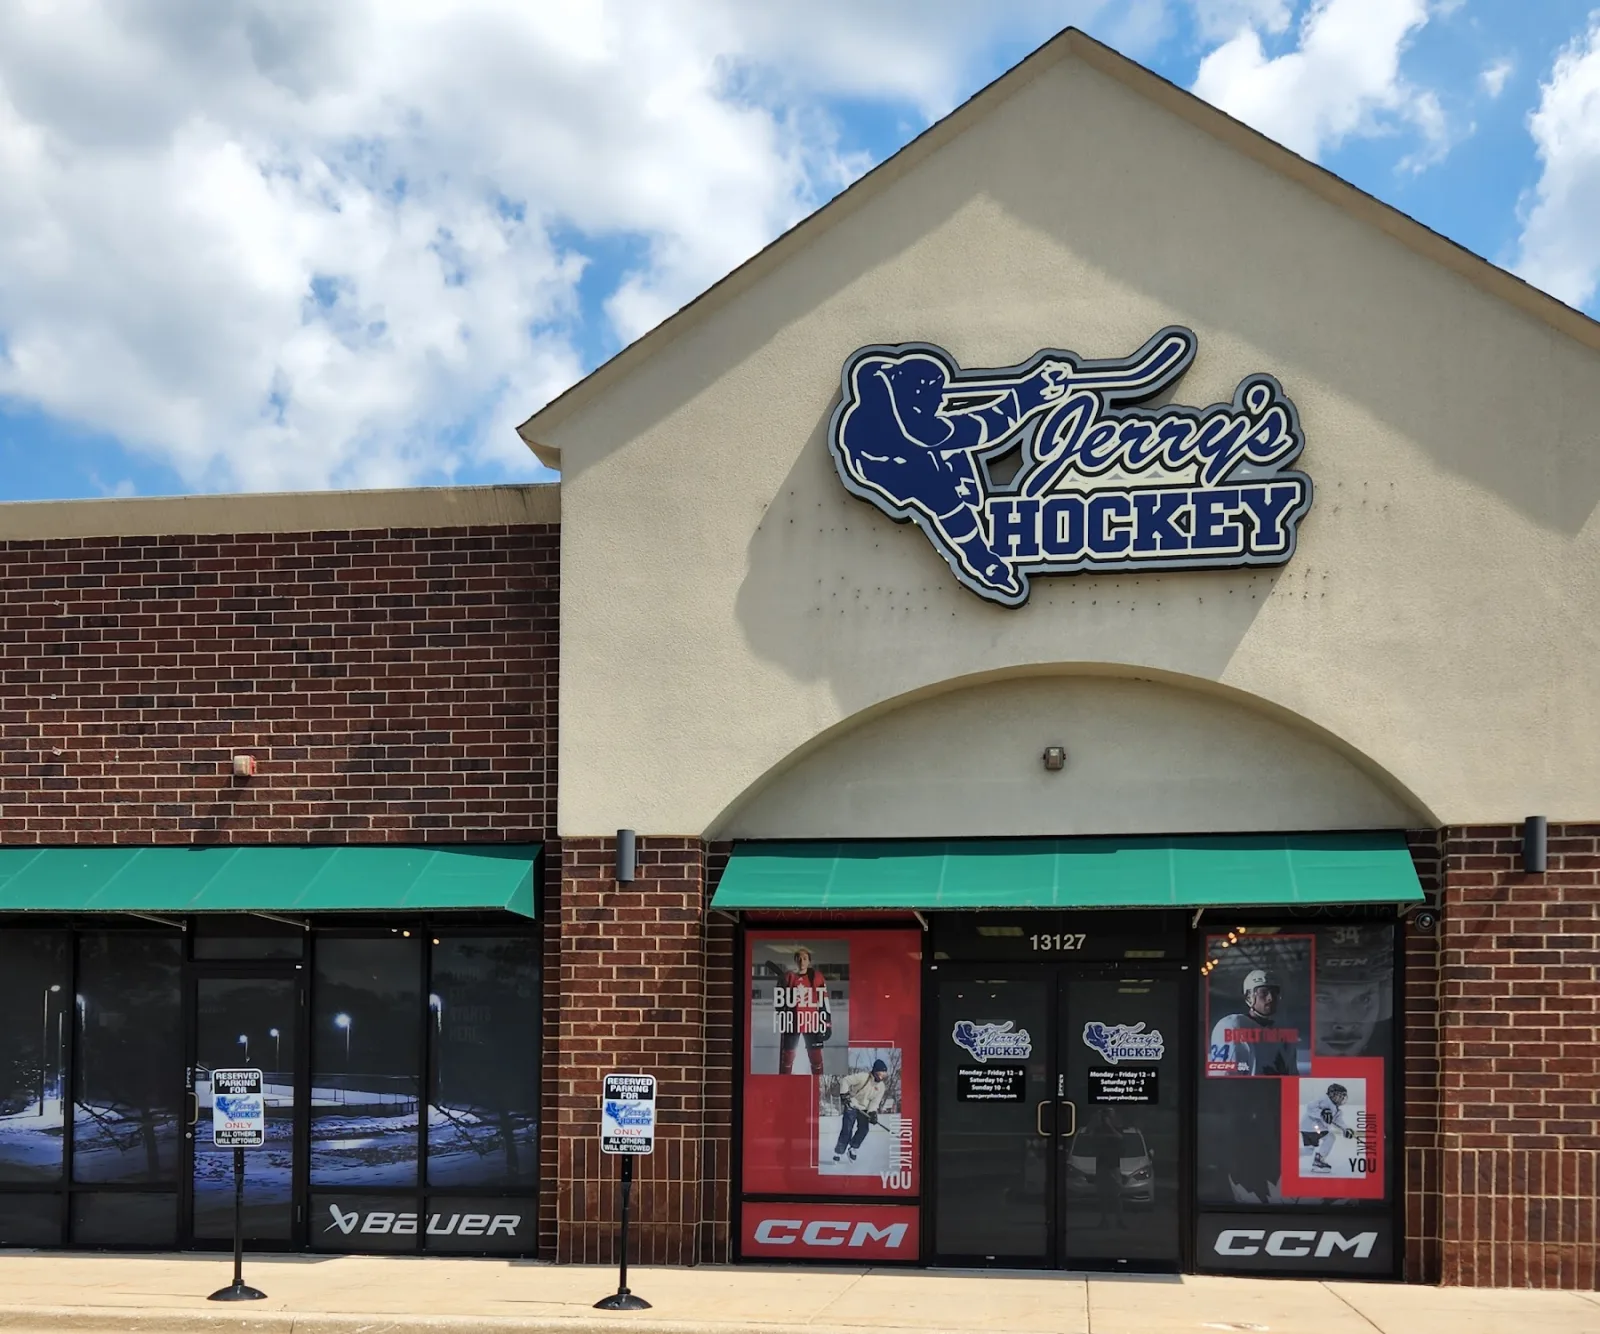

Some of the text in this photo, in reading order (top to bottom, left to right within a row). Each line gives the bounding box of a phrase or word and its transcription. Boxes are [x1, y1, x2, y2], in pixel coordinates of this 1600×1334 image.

[1021, 383, 1293, 497] Jerry's
[987, 482, 1301, 560] HOCKEY
[1029, 934, 1087, 951] 13127
[774, 987, 825, 1008] BUILT
[773, 1011, 826, 1033] FOR PROS
[986, 1031, 1027, 1046] Jerry's
[1117, 1032, 1159, 1047] Jerry's
[980, 1046, 1028, 1056] HOCKEY
[1111, 1047, 1161, 1057] HOCKEY
[215, 1072, 260, 1080] RESERVED
[959, 1069, 982, 1077] Monday
[988, 1069, 1005, 1077] Friday
[607, 1078, 653, 1086] RESERVED
[610, 1085, 649, 1093] PARKING
[1100, 1078, 1127, 1086] Saturday
[1103, 1086, 1125, 1094] Sunday
[228, 1110, 261, 1118] HOCKEY
[620, 1117, 652, 1125] HOCKEY
[889, 1114, 913, 1169] JUST LIKE
[1348, 1158, 1377, 1173] YOU
[880, 1171, 912, 1190] YOU
[753, 1219, 909, 1248] CCM
[1214, 1230, 1378, 1258] CCM
